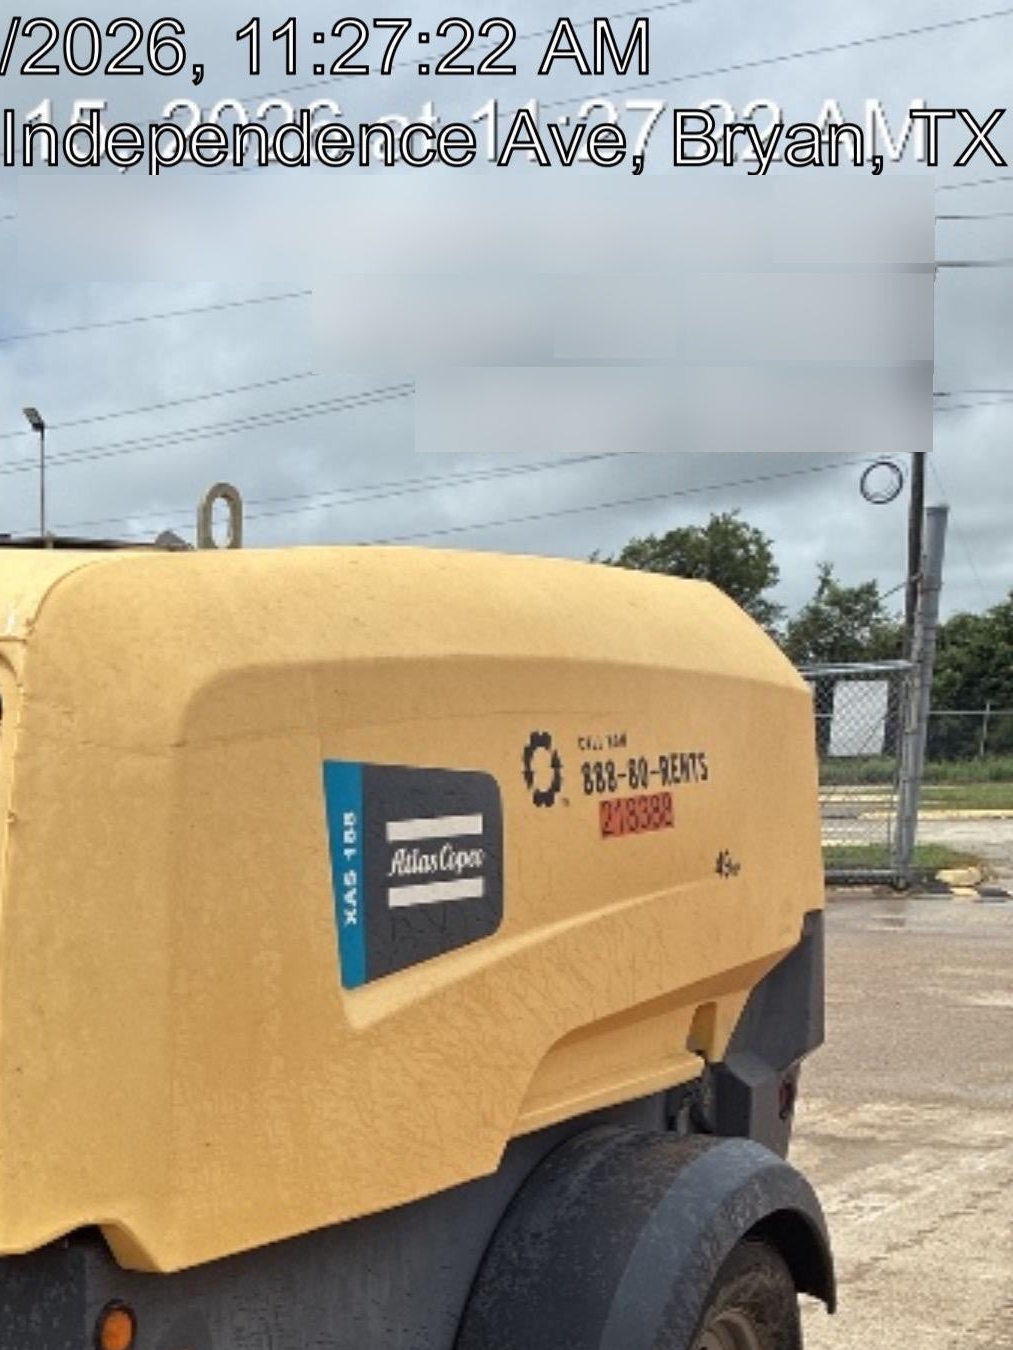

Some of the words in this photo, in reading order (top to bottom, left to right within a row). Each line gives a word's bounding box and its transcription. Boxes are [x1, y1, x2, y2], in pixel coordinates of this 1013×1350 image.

[386, 847, 438, 877] Atlas
[438, 842, 486, 875] Copco
[343, 869, 357, 927] XAS
